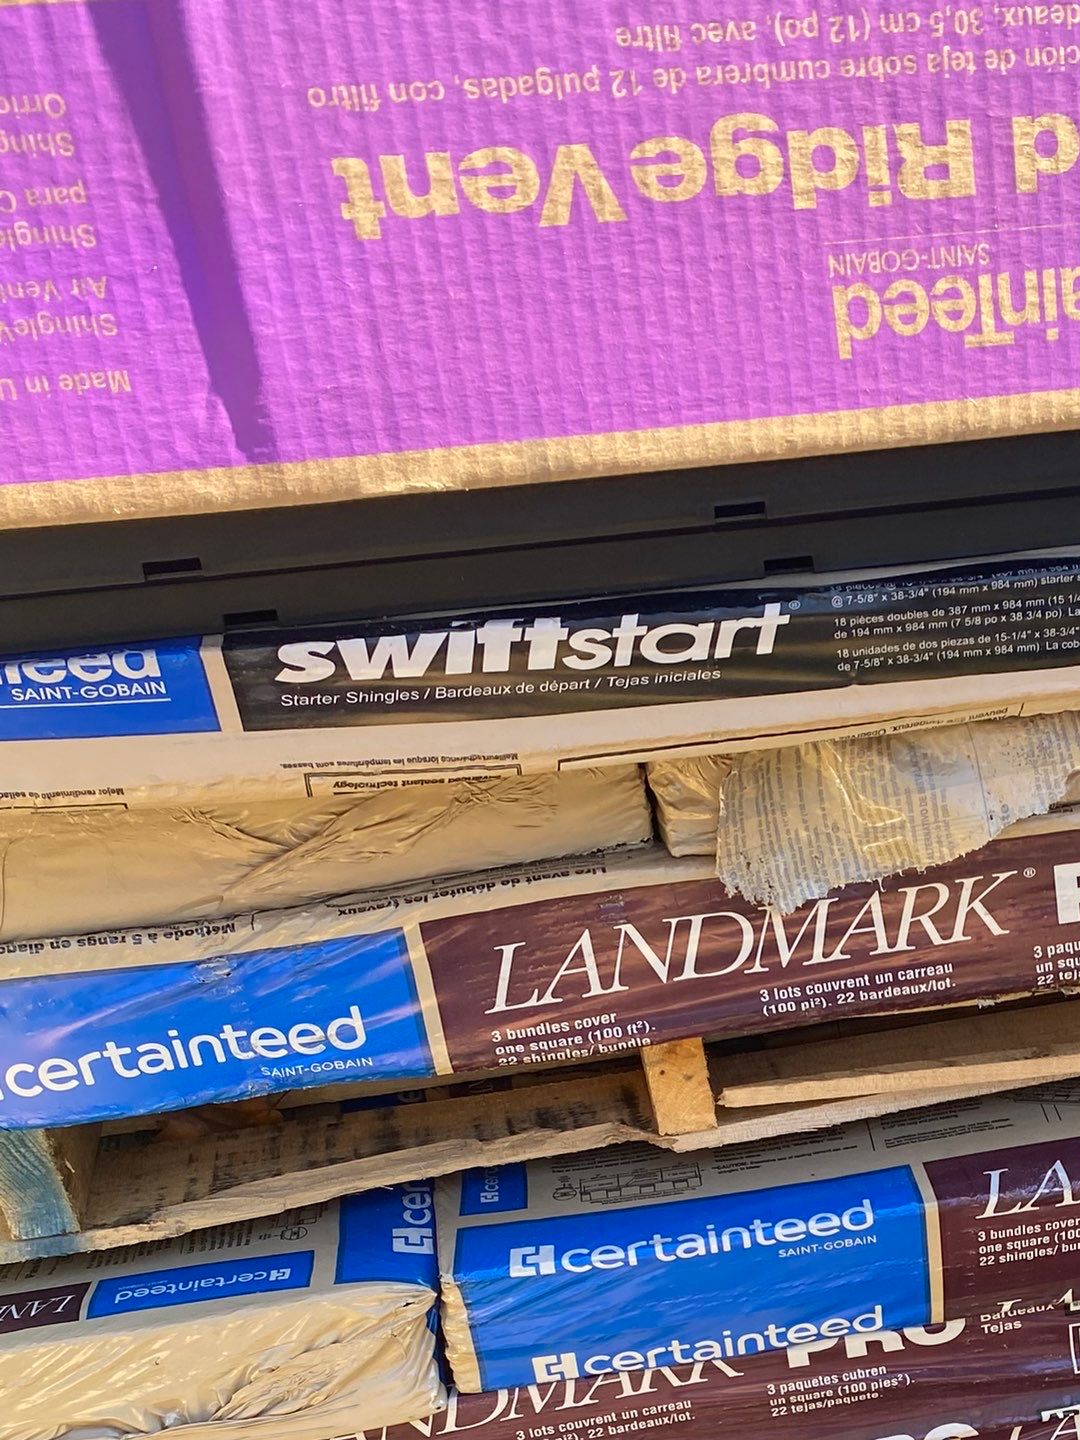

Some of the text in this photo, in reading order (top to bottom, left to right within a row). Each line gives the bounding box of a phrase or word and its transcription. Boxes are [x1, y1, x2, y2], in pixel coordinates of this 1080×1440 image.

[690, 20, 757, 47] avec
[766, 12, 818, 47] po),
[828, 8, 871, 43] (12
[879, 12, 920, 37] cm
[930, 5, 983, 37] 30,5
[615, 23, 681, 52] filtre
[694, 57, 831, 90] cumbrera
[840, 54, 917, 84] sobre
[927, 46, 976, 79] teja
[985, 50, 1016, 74] de
[388, 79, 444, 104] con
[453, 65, 600, 104] pulgadas,
[609, 69, 642, 97] 12
[653, 67, 686, 94] de
[306, 83, 381, 113] filtro
[630, 112, 976, 209] Ridge
[24, 180, 87, 207] para
[332, 143, 627, 240] Vent
[828, 242, 990, 279] SAINT-GOBAIN
[25, 370, 131, 397] Made in
[274, 602, 790, 683] swiftstart
[11, 681, 167, 702] SAINT-GOBAIN
[280, 669, 720, 708] Starter Shingles Bardeaux de départ Tejas iniciales
[484, 870, 1018, 1016] LANDMARK
[773, 963, 953, 1000] lots couvrent un carreau
[1035, 961, 1053, 973] un
[762, 1001, 796, 1016] (100
[837, 992, 857, 1005] 22
[860, 978, 957, 1002] bardeaux/lot.
[495, 1044, 525, 1055] one
[530, 1036, 584, 1052] square
[587, 1027, 623, 1045] (100
[506, 1012, 617, 1041] bundles cover
[5, 1005, 367, 1096] certainteed
[260, 1056, 372, 1077] SAINT-GOBAIN
[561, 1200, 875, 1273] certainteed
[778, 1235, 877, 1258] SAINT-GOBAIN
[583, 1305, 883, 1372] certainteed
